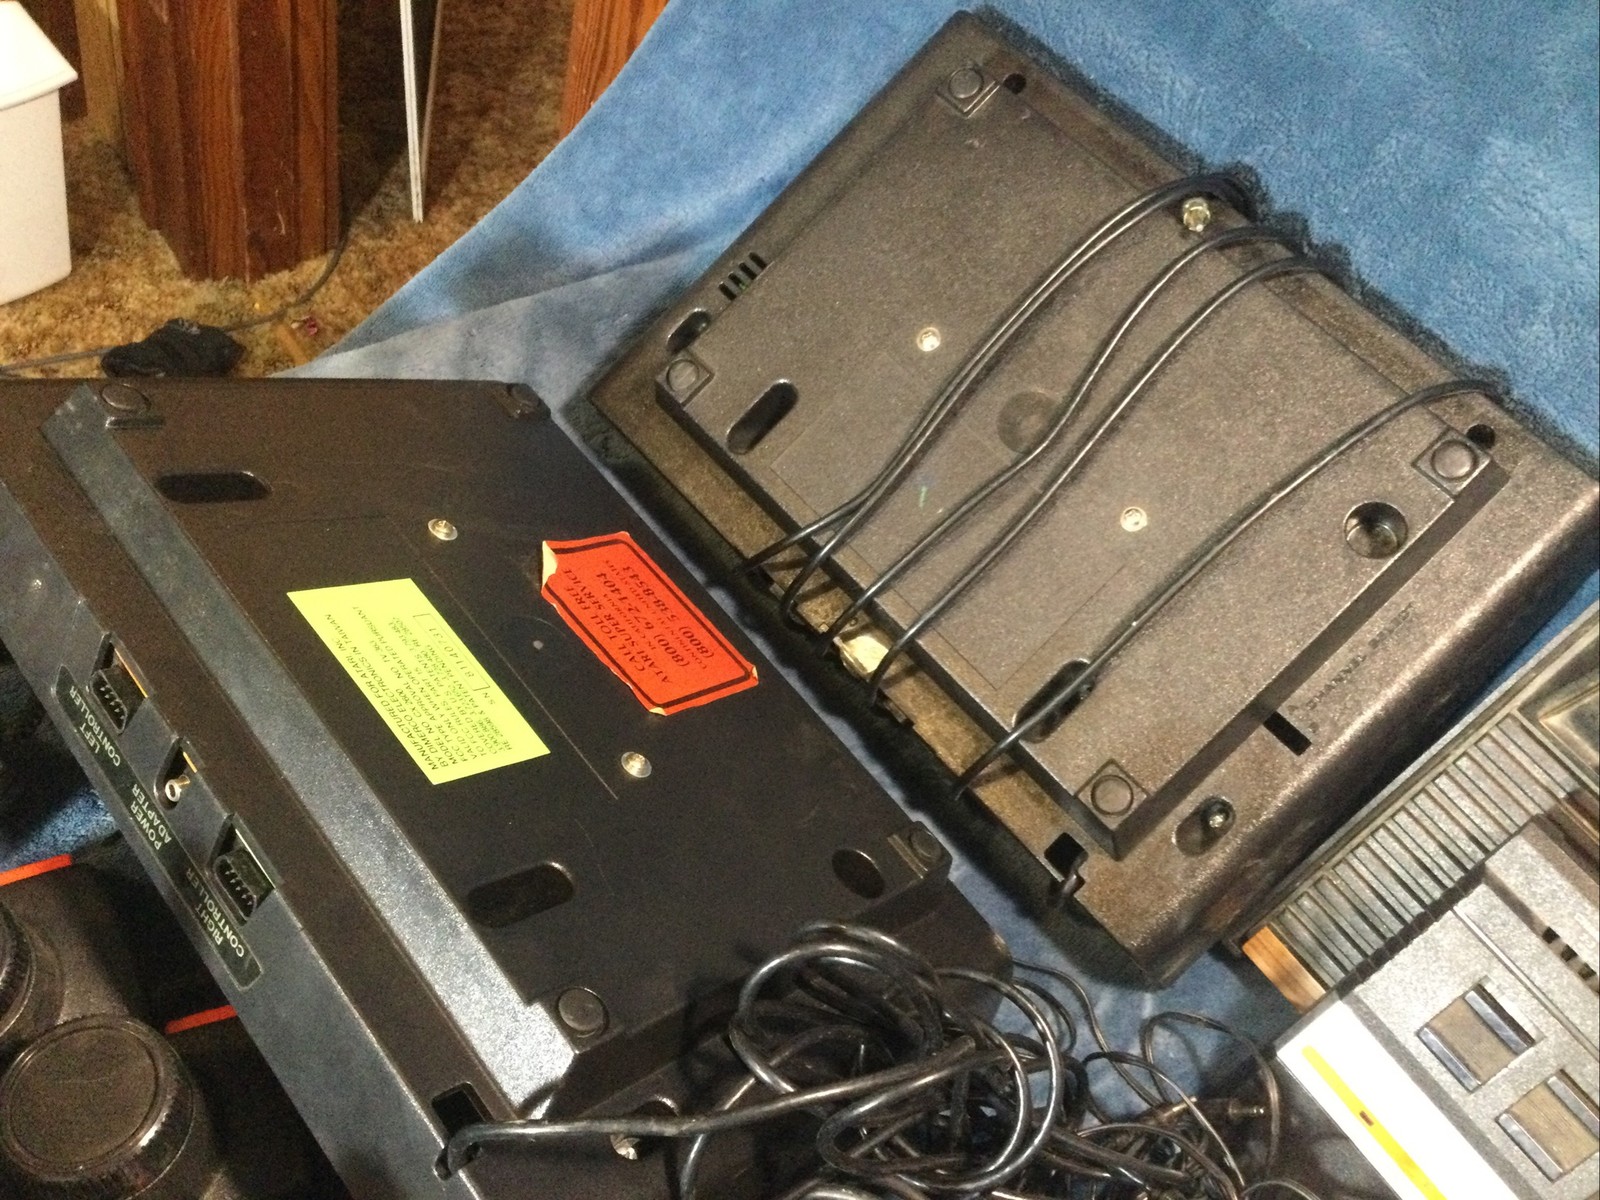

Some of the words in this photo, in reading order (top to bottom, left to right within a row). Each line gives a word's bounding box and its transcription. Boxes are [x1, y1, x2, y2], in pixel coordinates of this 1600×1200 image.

[561, 567, 605, 611] SERVICE
[594, 571, 655, 631] 672-1404
[620, 564, 680, 622] 538-8543
[323, 613, 352, 644] TAIWAN
[589, 614, 618, 640] TOLL
[602, 612, 639, 648] SUPER
[676, 624, 716, 659] (800)
[349, 646, 361, 655] IN
[383, 645, 421, 685] OPERATED
[615, 643, 647, 672] CALL
[635, 649, 673, 684] ATARI
[651, 632, 691, 668] (800)
[357, 655, 406, 712] ELECTRONICS
[364, 680, 384, 698] FOR
[401, 681, 437, 721] APPROVAL
[416, 686, 441, 711] WHEN
[421, 677, 441, 697] PART
[452, 679, 479, 708] PATENT
[66, 684, 123, 767] CONTROLLER
[78, 722, 102, 753] LEFT
[379, 699, 439, 770] MANUFACTURED
[402, 713, 438, 753] DIMERCO
[433, 723, 454, 742] TYPE
[437, 712, 459, 734] ONLY
[463, 716, 498, 754] COVERED
[431, 735, 459, 764] MODEL
[434, 755, 449, 767] BY
[450, 744, 469, 762] FCC
[454, 734, 479, 759] VALID
[474, 744, 488, 756] TO
[128, 799, 164, 850] POWER
[130, 782, 173, 843] ADAPTER
[183, 866, 247, 957] CONTROLLER
[193, 901, 225, 945] RIGHT
